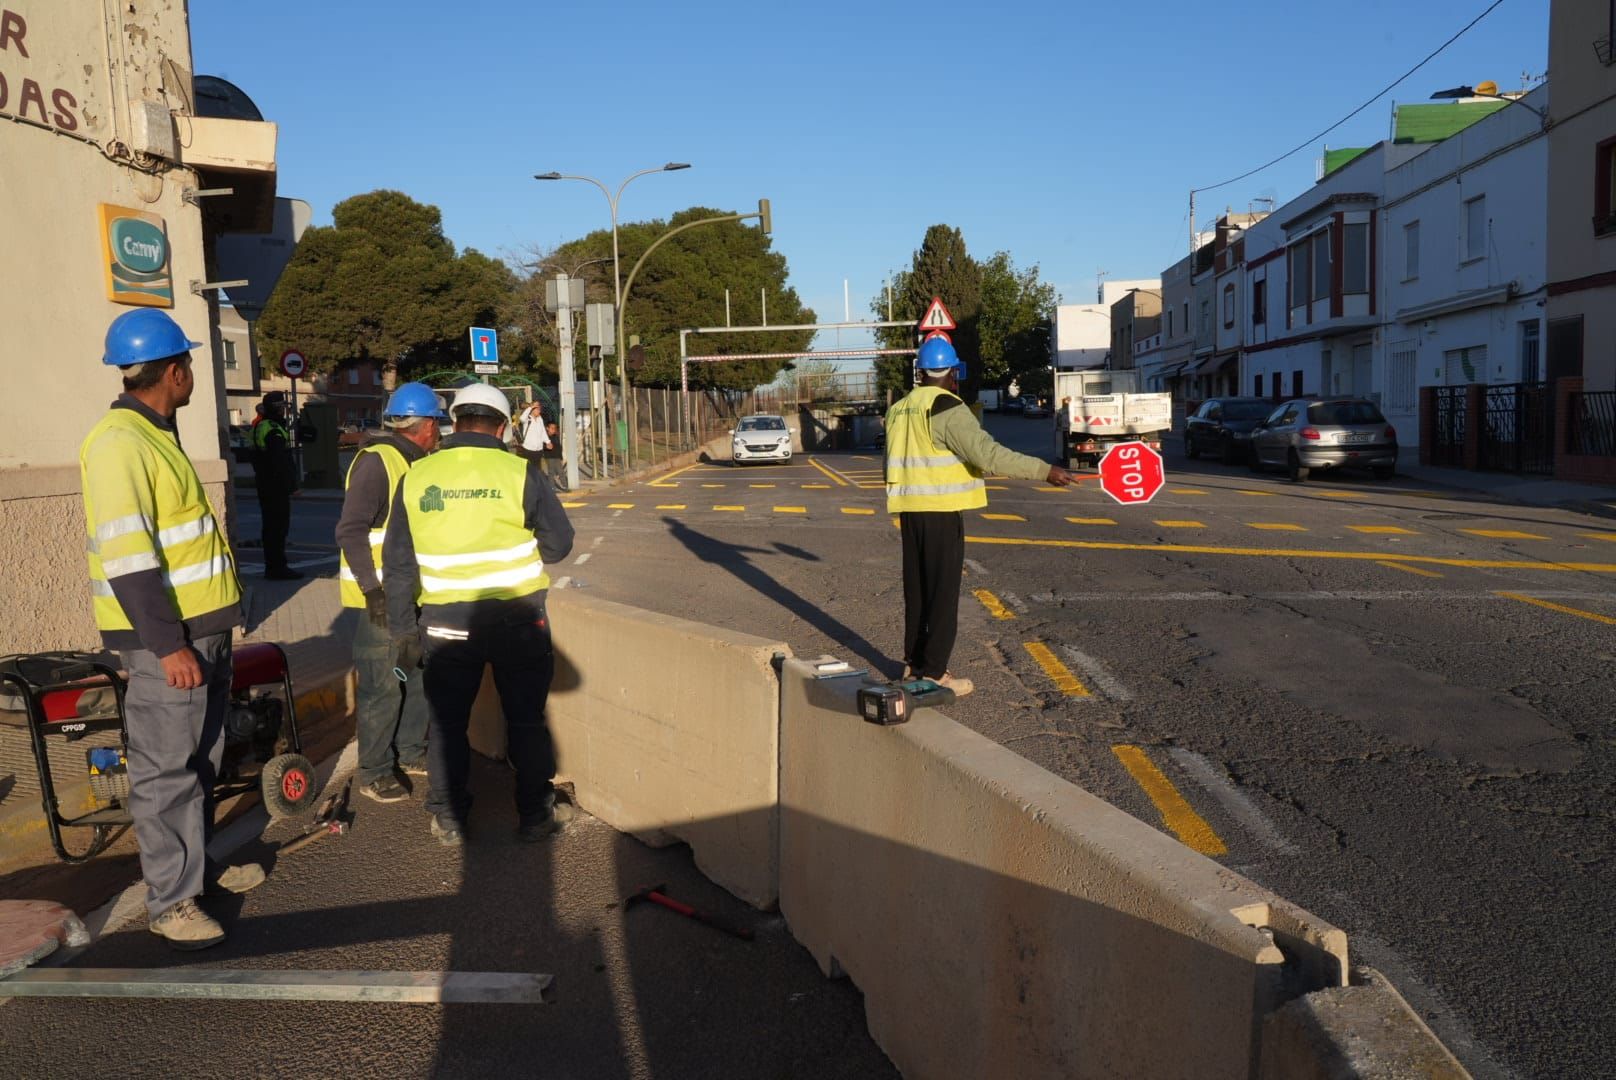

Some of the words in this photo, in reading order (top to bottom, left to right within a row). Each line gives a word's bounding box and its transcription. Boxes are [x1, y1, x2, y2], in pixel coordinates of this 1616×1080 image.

[123, 236, 161, 263] Camy
[1119, 447, 1144, 499] STOP
[442, 488, 489, 499] NOUTEMPS
